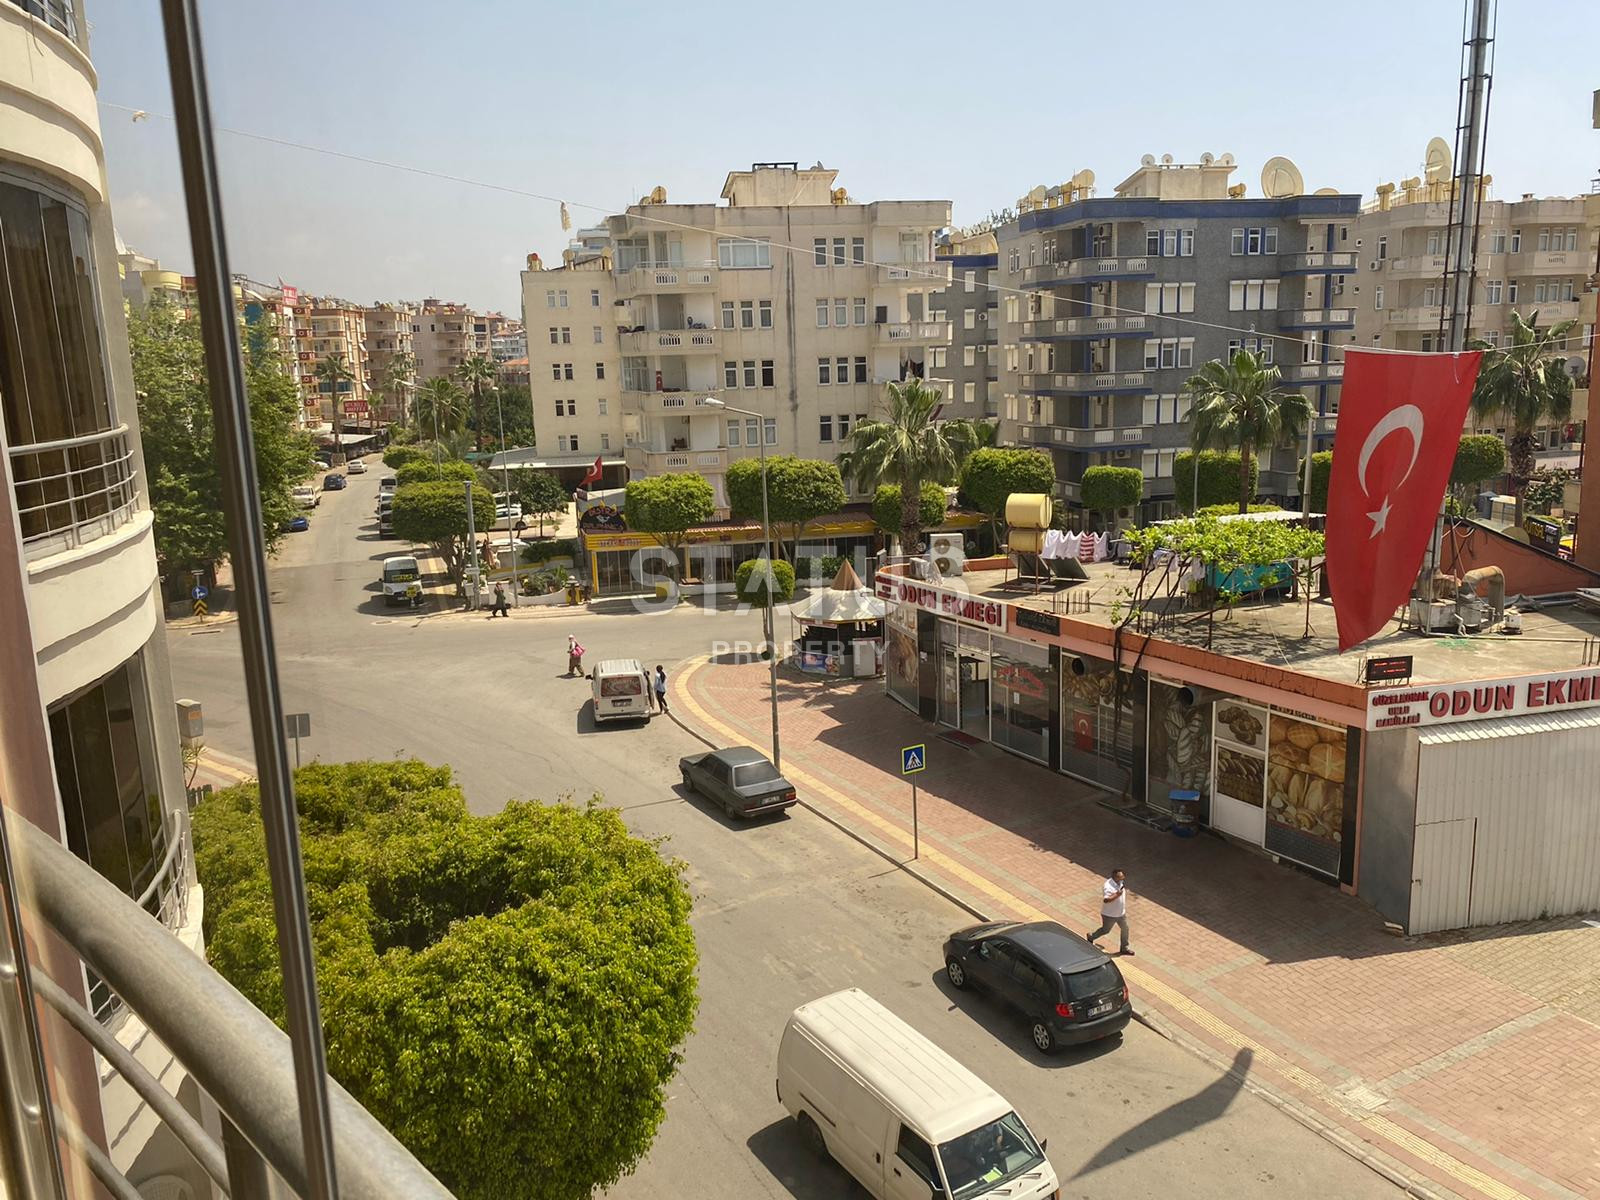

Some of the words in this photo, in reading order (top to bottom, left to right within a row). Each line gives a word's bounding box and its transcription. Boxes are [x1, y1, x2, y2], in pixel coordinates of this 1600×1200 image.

[897, 583, 936, 610] ODUN
[942, 593, 1002, 626] EKMEĞİ
[1430, 684, 1515, 718] ODUN
